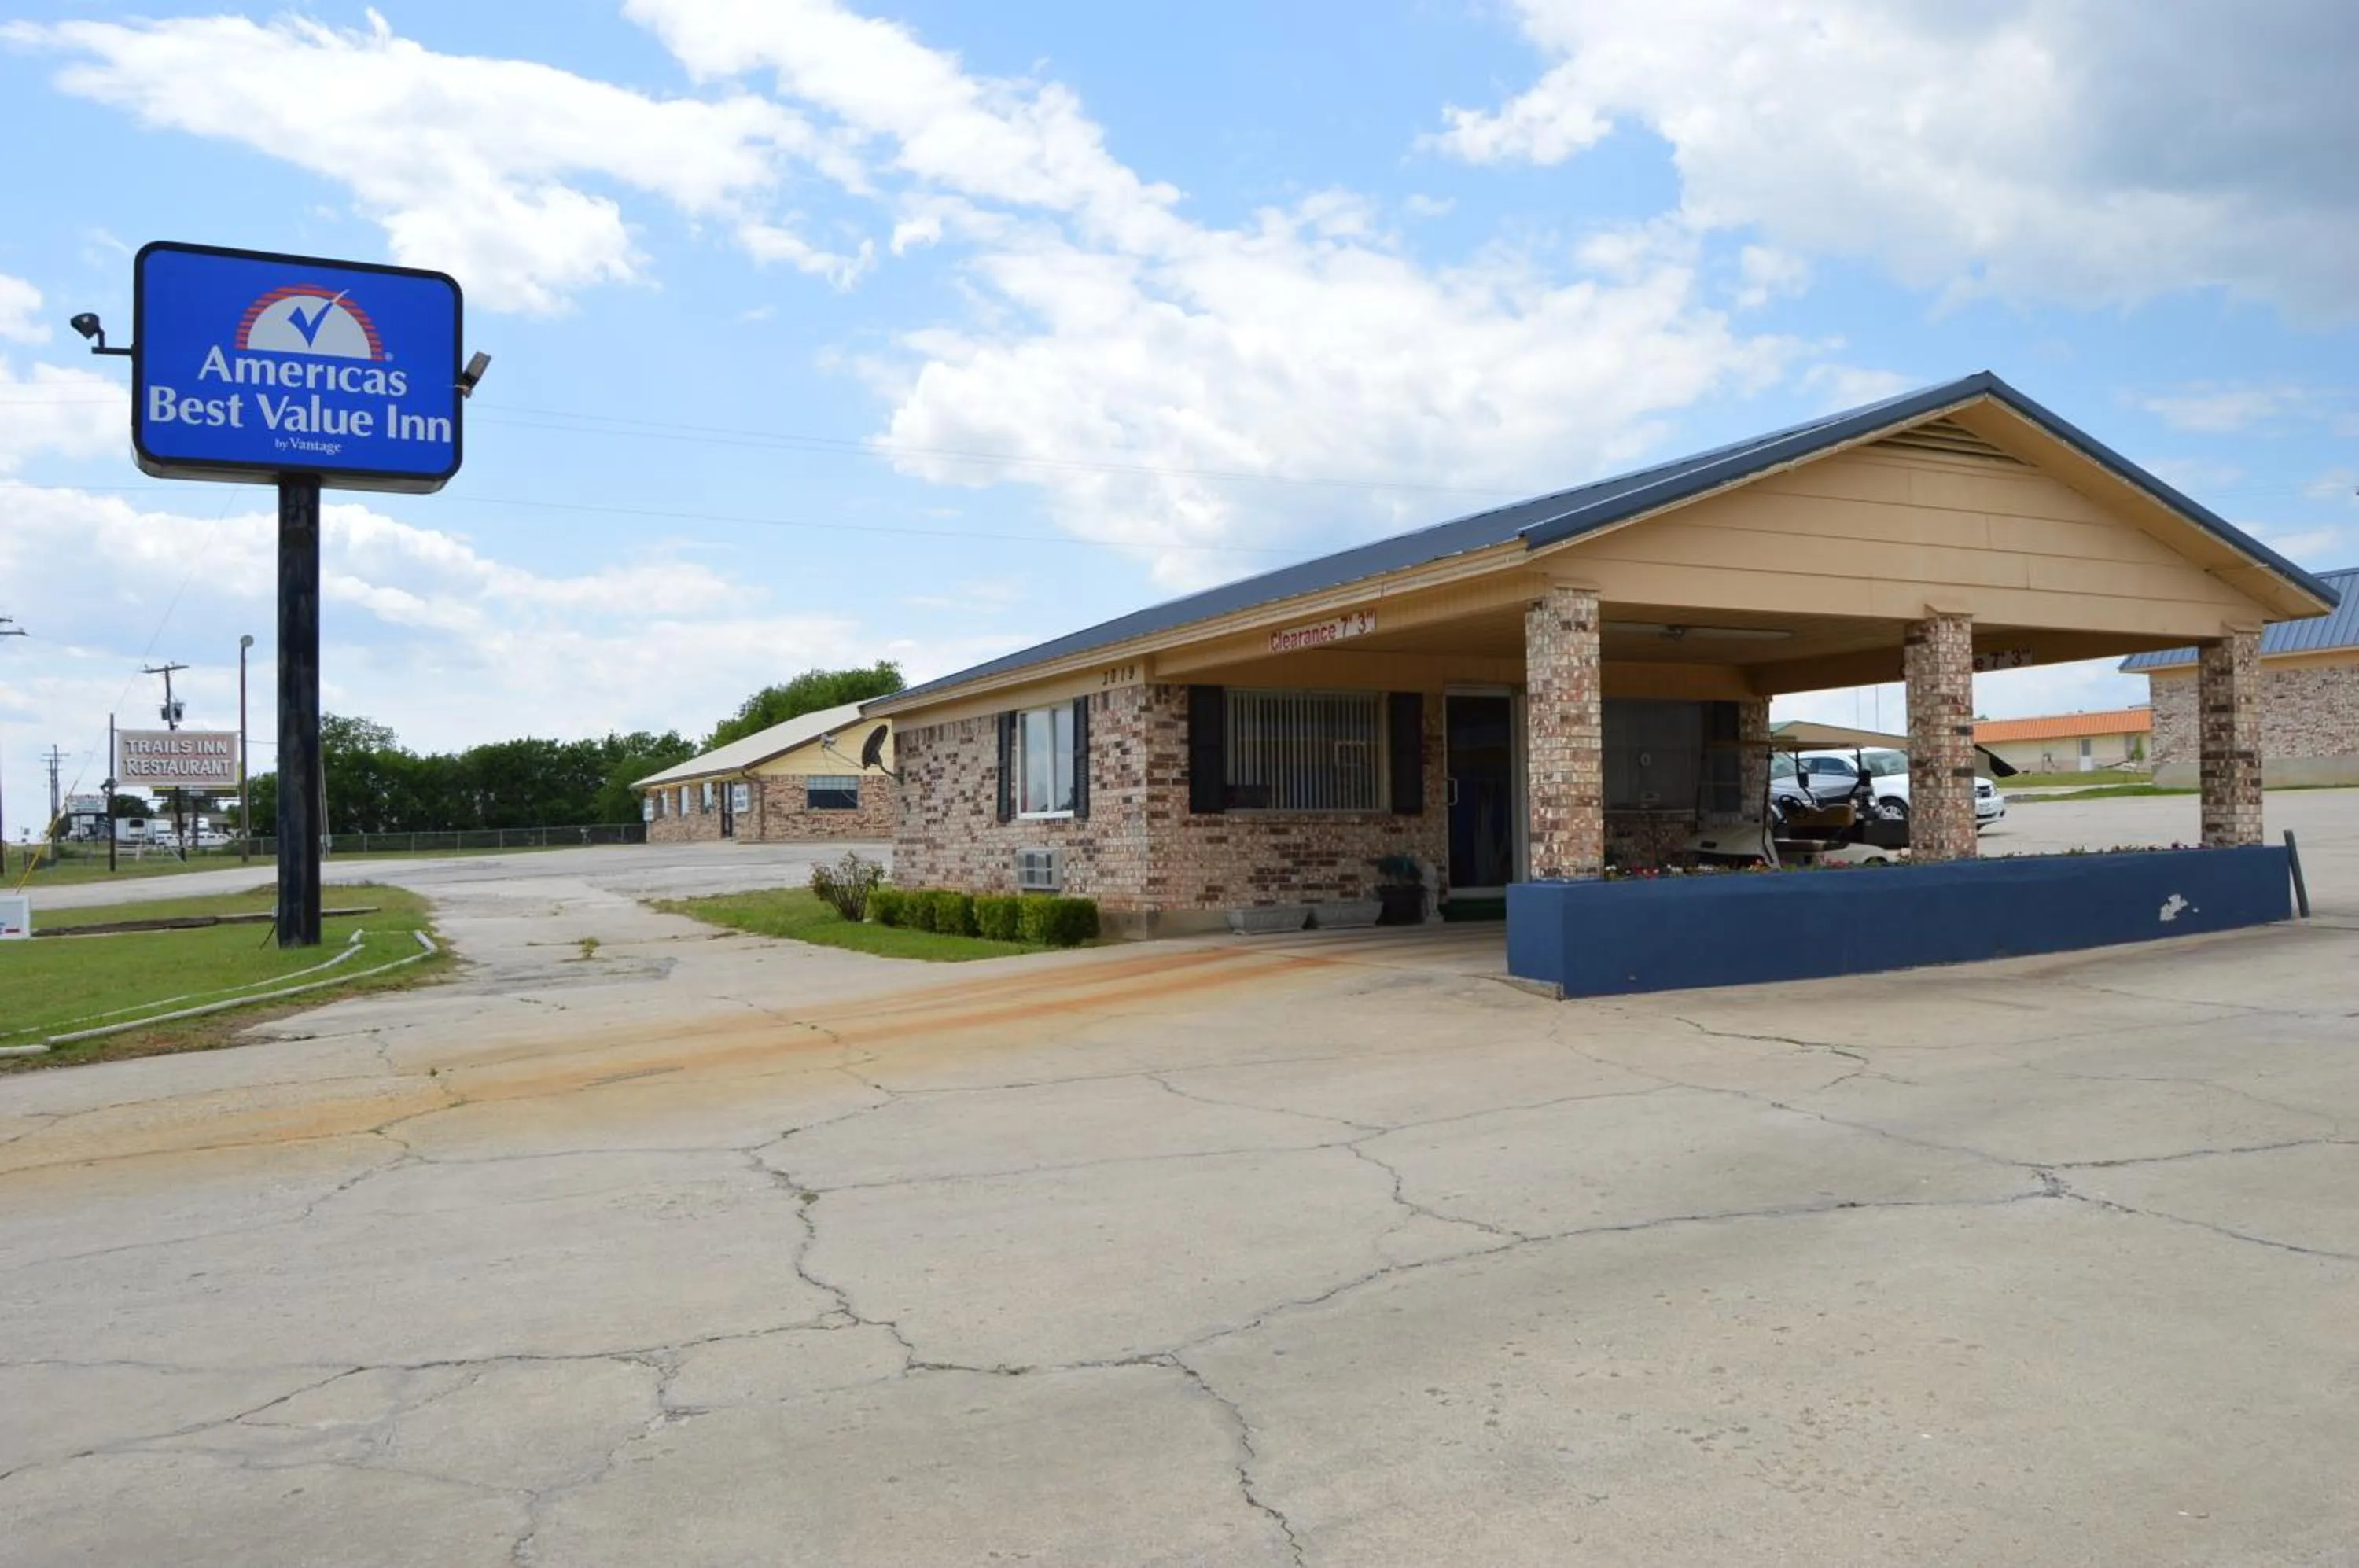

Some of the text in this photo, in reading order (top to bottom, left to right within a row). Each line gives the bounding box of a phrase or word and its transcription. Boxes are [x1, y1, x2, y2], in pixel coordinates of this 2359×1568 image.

[198, 344, 407, 397] Americas
[149, 385, 451, 443] Best Value Inn
[274, 436, 341, 455] by Vantage
[1270, 623, 1336, 651] Clearance
[125, 739, 227, 755] TRAILS INN
[125, 758, 231, 776] RESTAURANT
